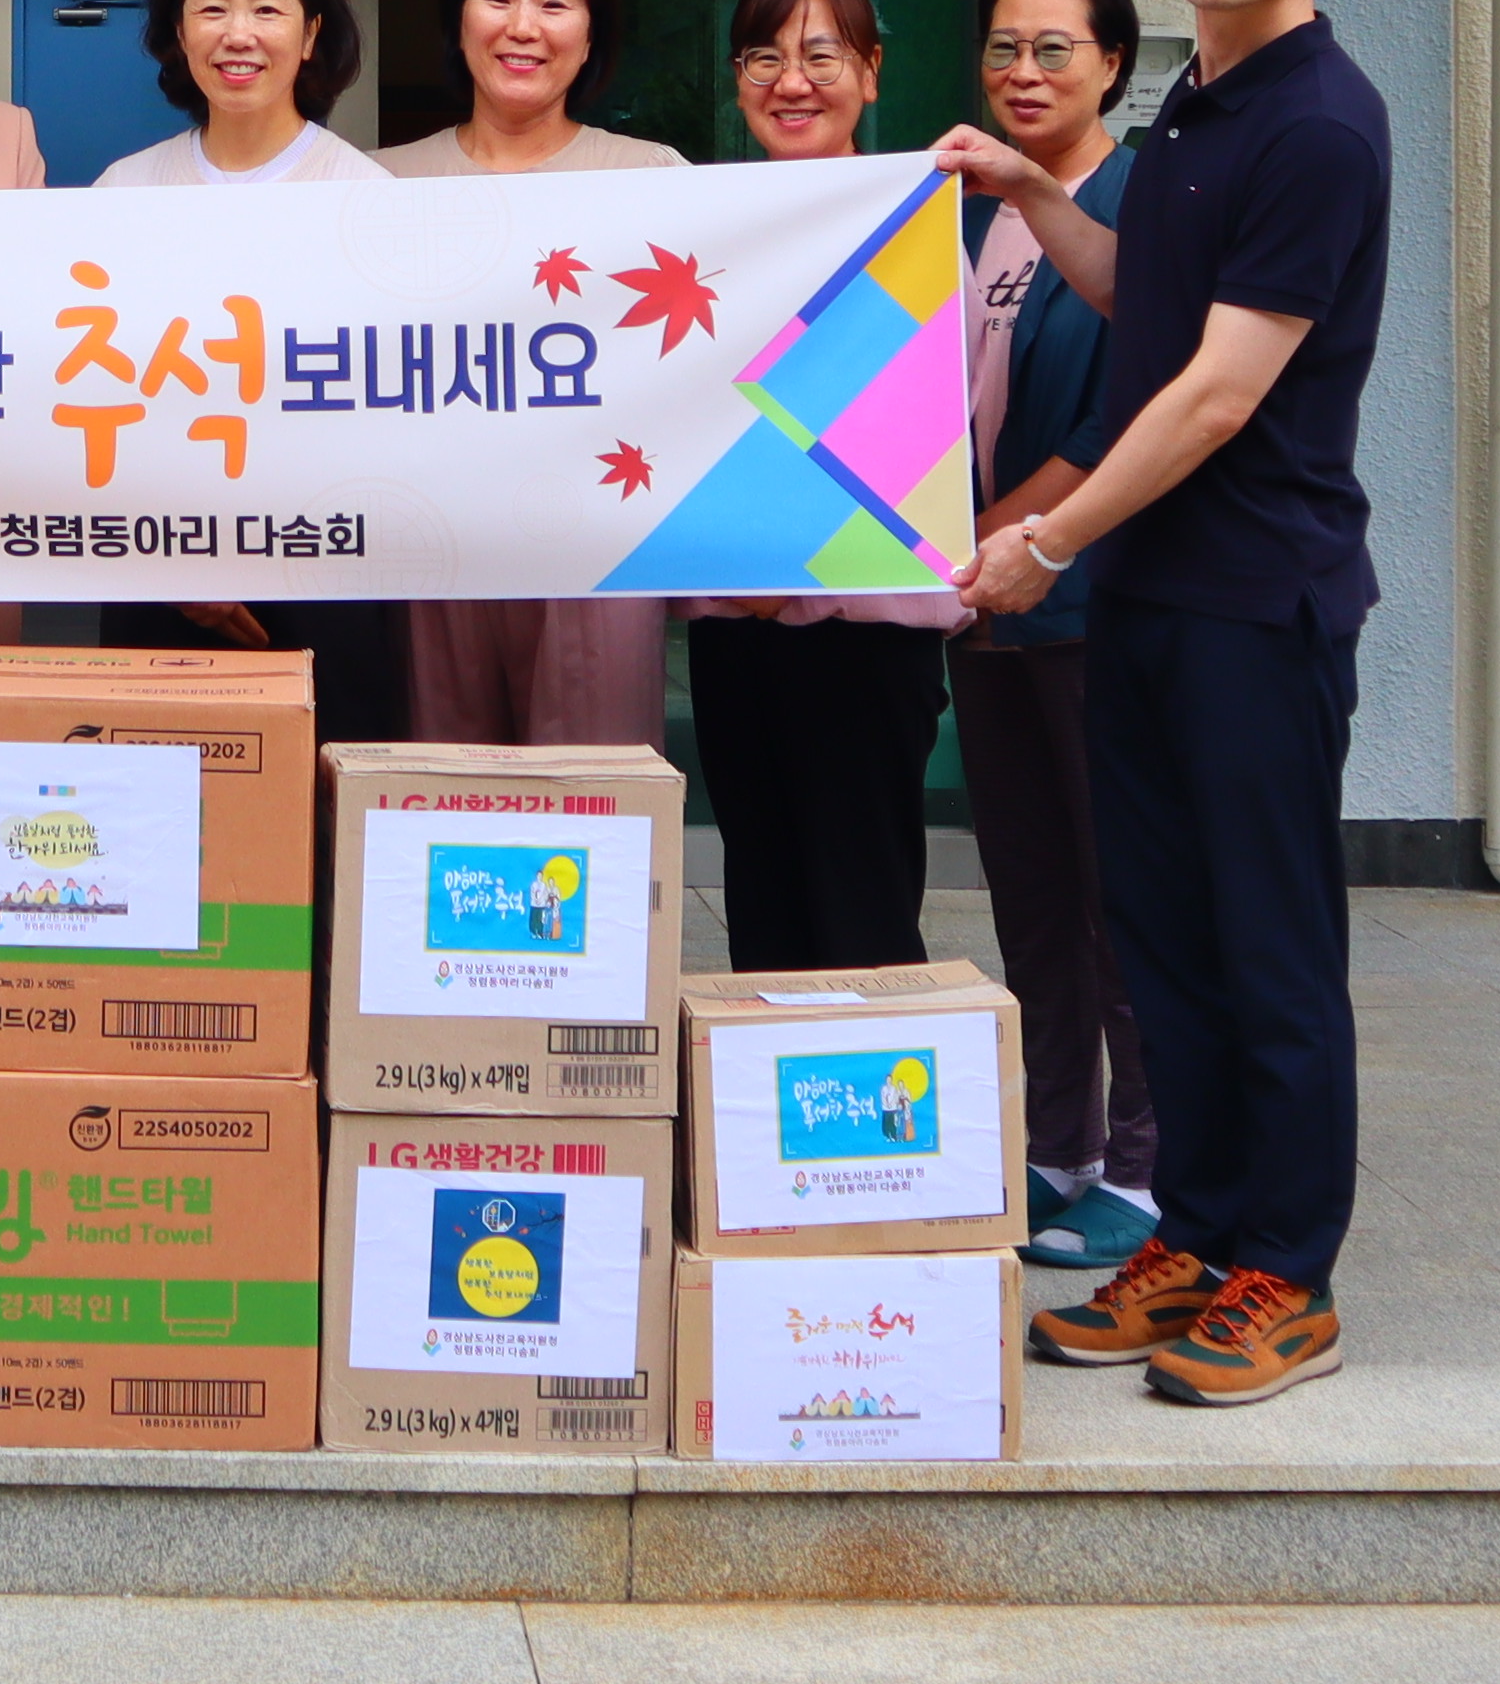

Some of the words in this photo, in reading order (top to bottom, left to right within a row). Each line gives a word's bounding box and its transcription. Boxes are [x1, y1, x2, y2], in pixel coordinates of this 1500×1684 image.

[51, 260, 267, 489] 추석
[280, 321, 602, 415] 보내세요
[0, 513, 218, 559] 청렴동아리
[235, 513, 366, 558] 다솜회
[130, 1041, 233, 1053] 18803628118817
[375, 1064, 403, 1089] 2.9
[439, 1064, 467, 1095] kg)
[471, 1073, 482, 1089] x
[485, 1064, 529, 1095] 4개입
[560, 1088, 646, 1097] 10800212
[76, 1123, 104, 1135] 친환경
[133, 1120, 253, 1138] 22S4050202
[67, 1173, 212, 1215] 핸드타월
[66, 1222, 131, 1244] Hand
[138, 1223, 213, 1245] Towel
[139, 1418, 241, 1429] 18803628118817
[365, 1408, 392, 1432] 2.9
[429, 1408, 456, 1438] kg)
[460, 1415, 471, 1432] x
[475, 1408, 519, 1438] 4개입
[550, 1431, 634, 1440] 10800212
